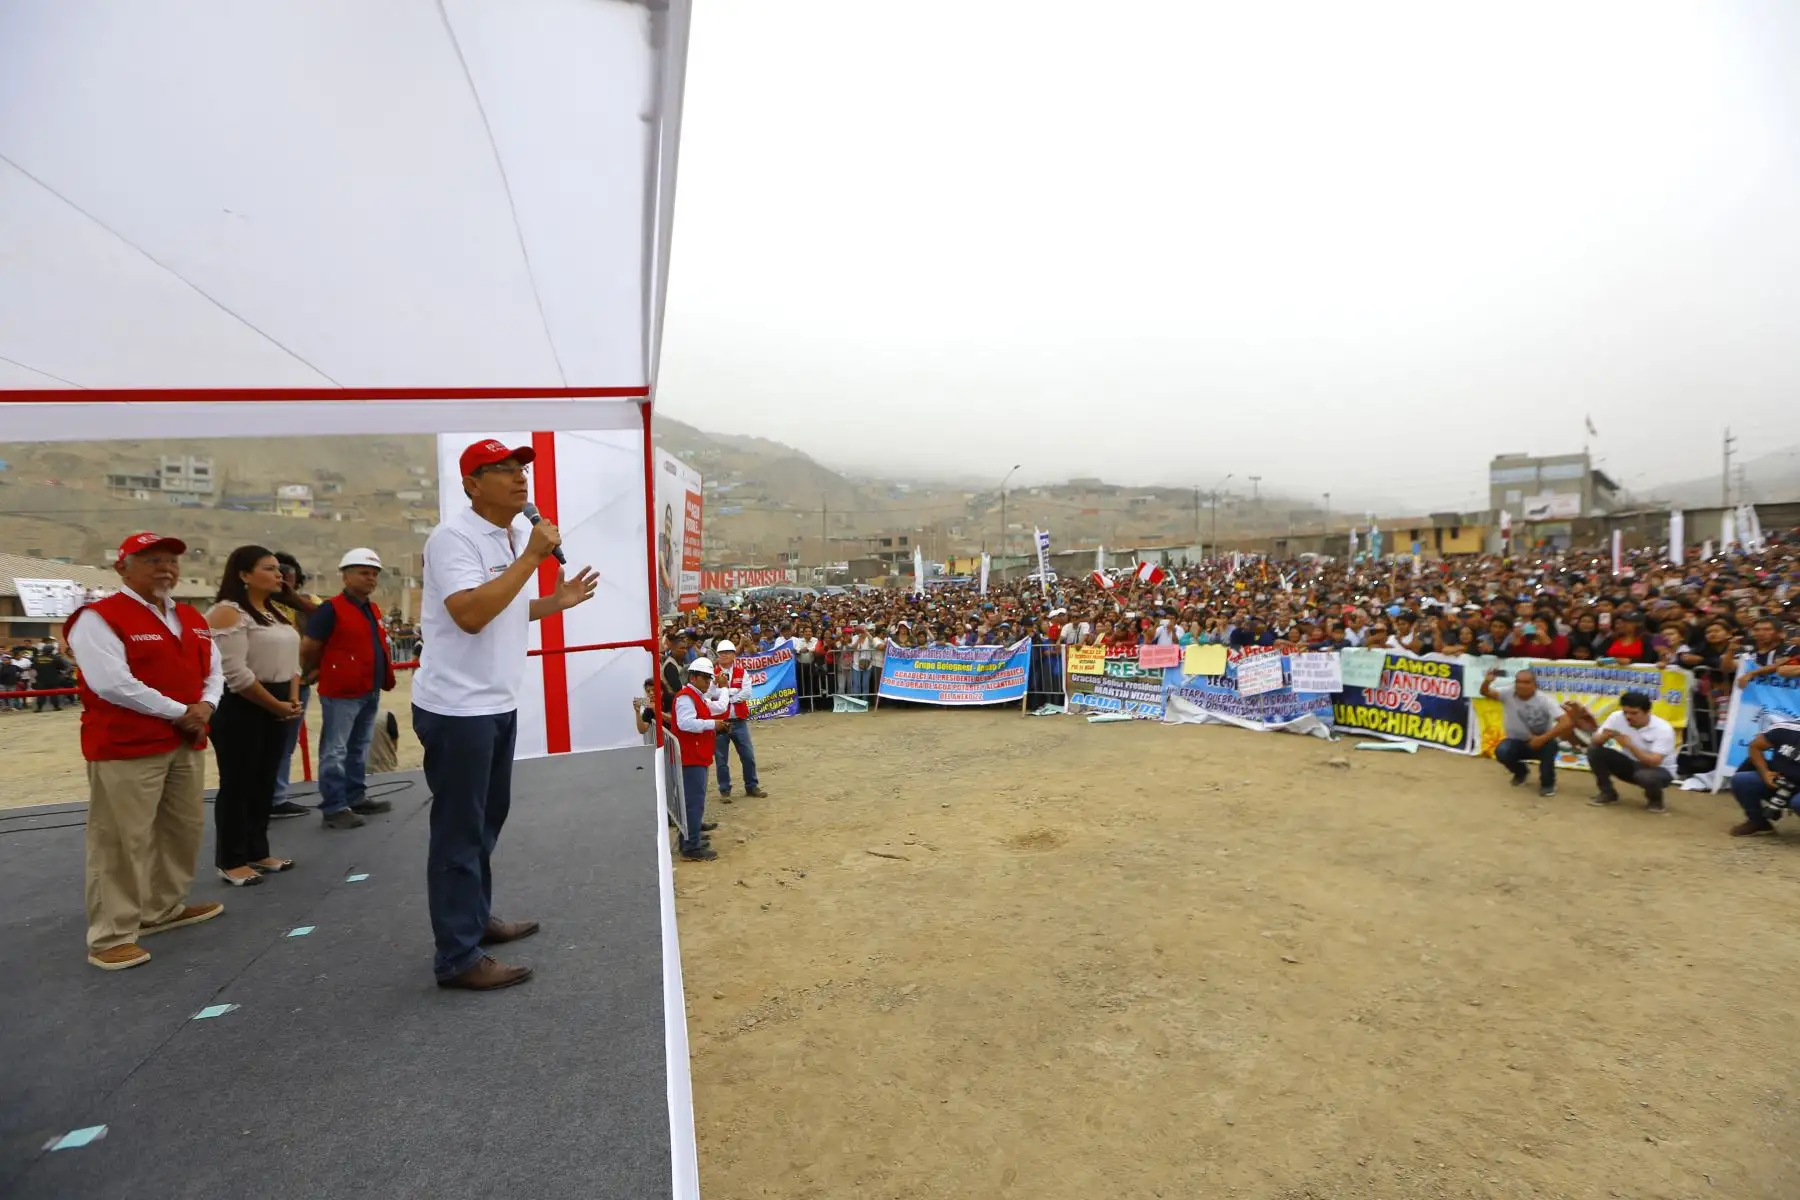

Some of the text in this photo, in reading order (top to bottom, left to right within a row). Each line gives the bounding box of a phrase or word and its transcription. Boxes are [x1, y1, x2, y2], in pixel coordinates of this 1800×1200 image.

[130, 634, 164, 642] VIVIENDA
[914, 660, 936, 669] Grupo
[936, 662, 972, 671] Bolognesi
[1385, 656, 1451, 678] LAMOS
[894, 671, 927, 679] AGRADECE
[937, 673, 973, 682] PRESIDENTE
[1072, 674, 1101, 685] Gracias
[905, 681, 923, 689] OBRA
[1391, 671, 1462, 700] ANTONIO
[778, 688, 796, 699] OBRA
[1180, 688, 1205, 699] ETAPA
[1070, 693, 1121, 710] AGUA
[1124, 700, 1138, 712] Y
[1362, 687, 1423, 714] 100%
[1206, 700, 1240, 714] DISTRITO
[1334, 703, 1464, 747] UAROCHIRANO
